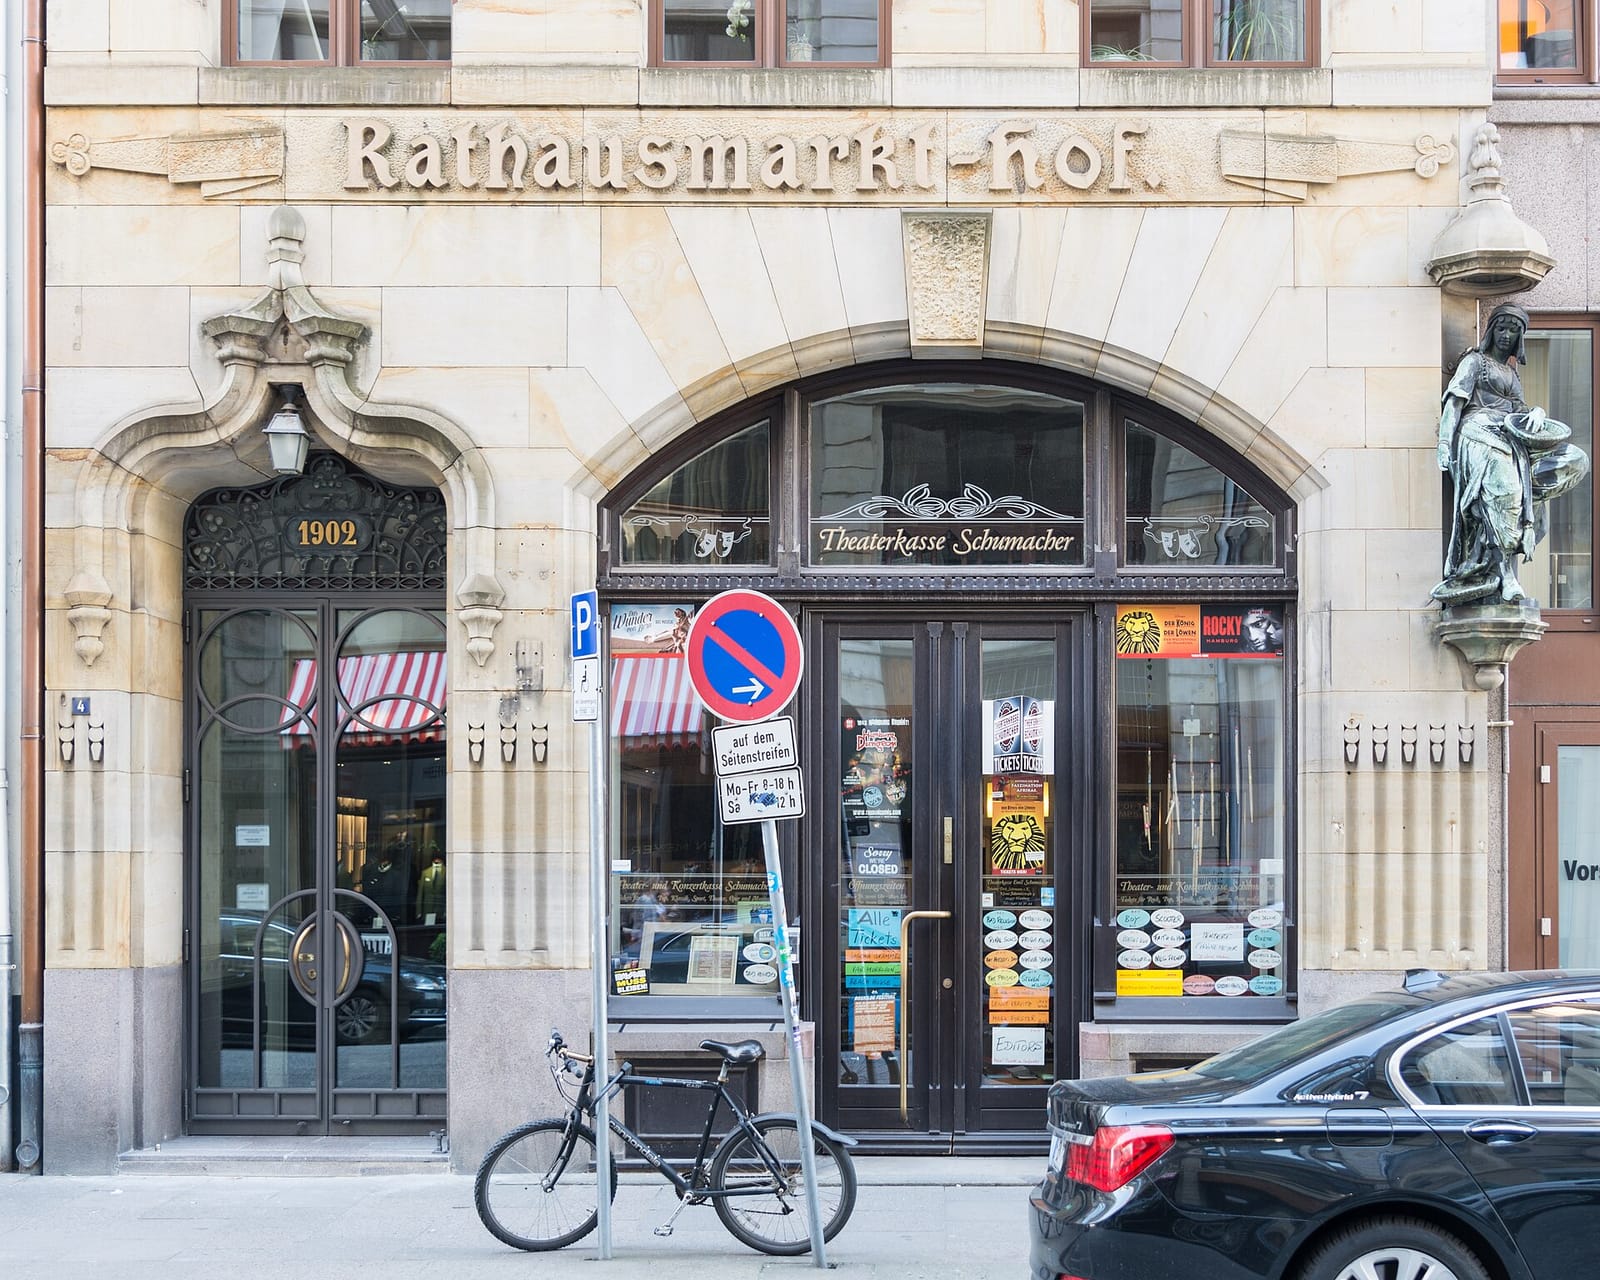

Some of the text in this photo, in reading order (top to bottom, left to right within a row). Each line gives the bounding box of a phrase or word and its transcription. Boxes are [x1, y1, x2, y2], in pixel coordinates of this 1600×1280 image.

[298, 520, 357, 545] 1902
[819, 526, 1075, 557] Theaterkasse Schumacher
[576, 601, 592, 650] P
[613, 612, 653, 630] Wunder
[1203, 615, 1243, 636] ROCKY
[77, 700, 85, 713] 4
[733, 731, 775, 748] auf dem
[721, 746, 790, 767] Seitenstreifen
[994, 756, 1020, 773] TICKETS
[726, 776, 795, 797] Mo-Fr 8-18 h
[728, 800, 741, 814] Sa
[789, 795, 797, 808] h
[863, 846, 892, 862] Sorry
[858, 863, 899, 874] CLOSED
[1563, 860, 1600, 881] Vor
[652, 881, 668, 890] und
[1120, 881, 1153, 892] Theater-
[1157, 882, 1173, 891] und
[857, 911, 890, 926] Alle
[1125, 914, 1140, 924] BOY
[850, 929, 897, 945] Tickets
[996, 1036, 1043, 1052] EDITORS
